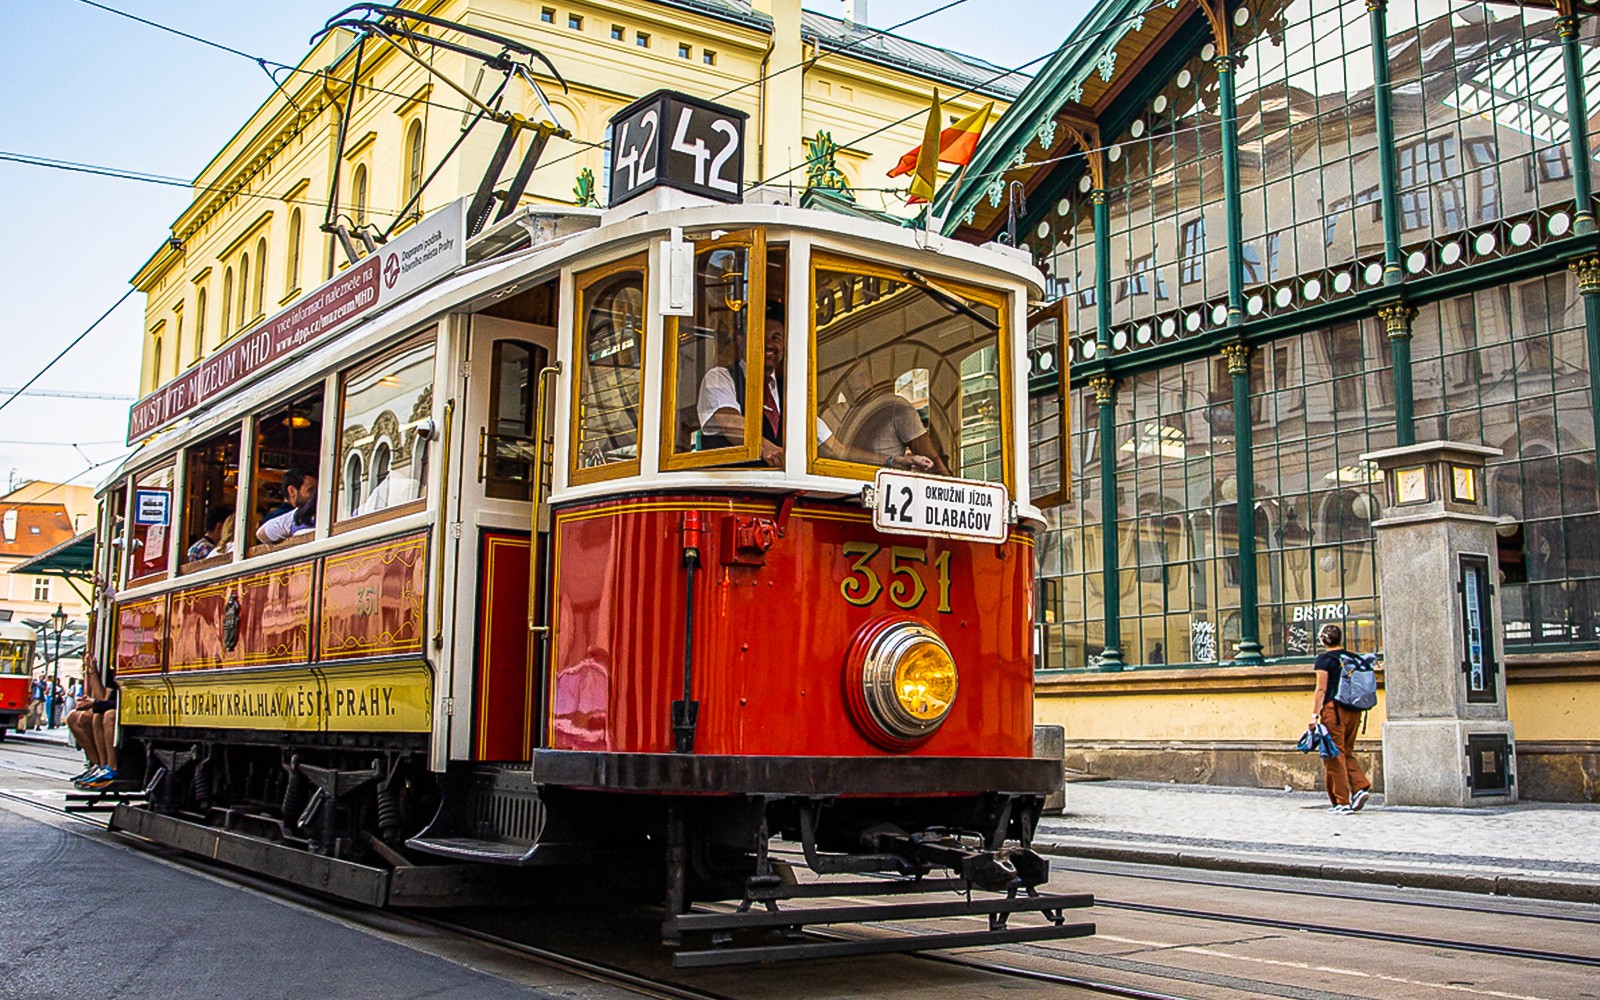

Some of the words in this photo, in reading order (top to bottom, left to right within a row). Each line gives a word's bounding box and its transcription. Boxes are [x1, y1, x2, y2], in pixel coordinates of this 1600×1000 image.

[616, 110, 658, 190] 42
[671, 107, 739, 194] 42
[363, 268, 373, 283] na
[276, 286, 374, 352] www.dpp.cz/muzeumMHD
[188, 351, 236, 405] MUZEUM
[240, 332, 271, 373] MHD
[884, 484, 913, 523] 42
[925, 486, 965, 504] OKRUŽNÍ
[968, 488, 993, 507] JÍZDA
[925, 506, 992, 531] DLABAČOV
[840, 541, 953, 614] 351
[357, 585, 379, 616] 351
[1293, 602, 1349, 622] BISTRO
[192, 690, 225, 716] DRÁHY
[336, 687, 395, 717] PRAHY.
